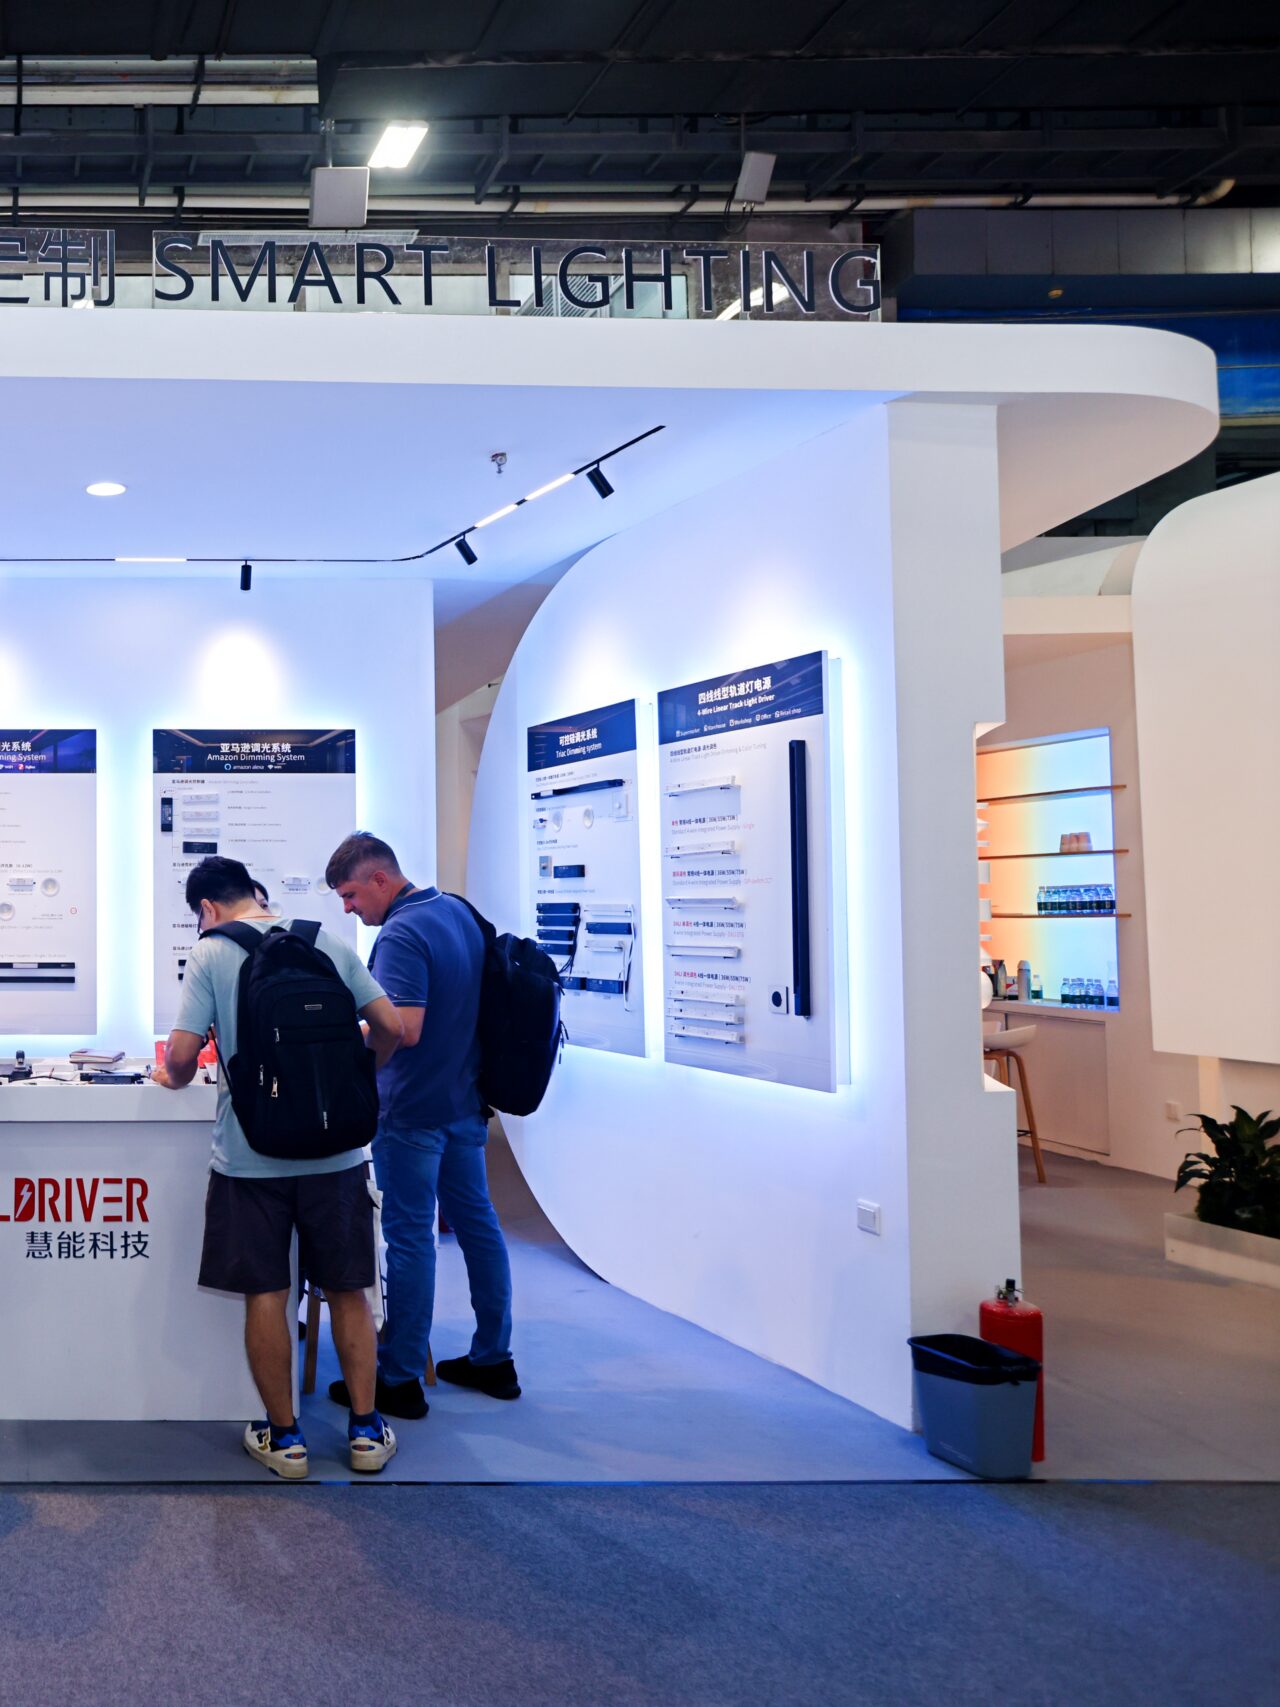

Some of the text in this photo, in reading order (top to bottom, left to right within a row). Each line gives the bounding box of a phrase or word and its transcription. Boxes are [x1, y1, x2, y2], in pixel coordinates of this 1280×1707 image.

[154, 237, 881, 315] SMART LIGHTING
[713, 703, 728, 714] Linear
[729, 700, 743, 710] Track
[744, 697, 758, 708] Light
[758, 694, 775, 704] Driver
[220, 743, 291, 753] 亚马逊调光系统
[18, 753, 46, 763] System
[240, 753, 275, 762] Dimming
[277, 754, 305, 762] System
[25, 1230, 150, 1259] 慧能科技
